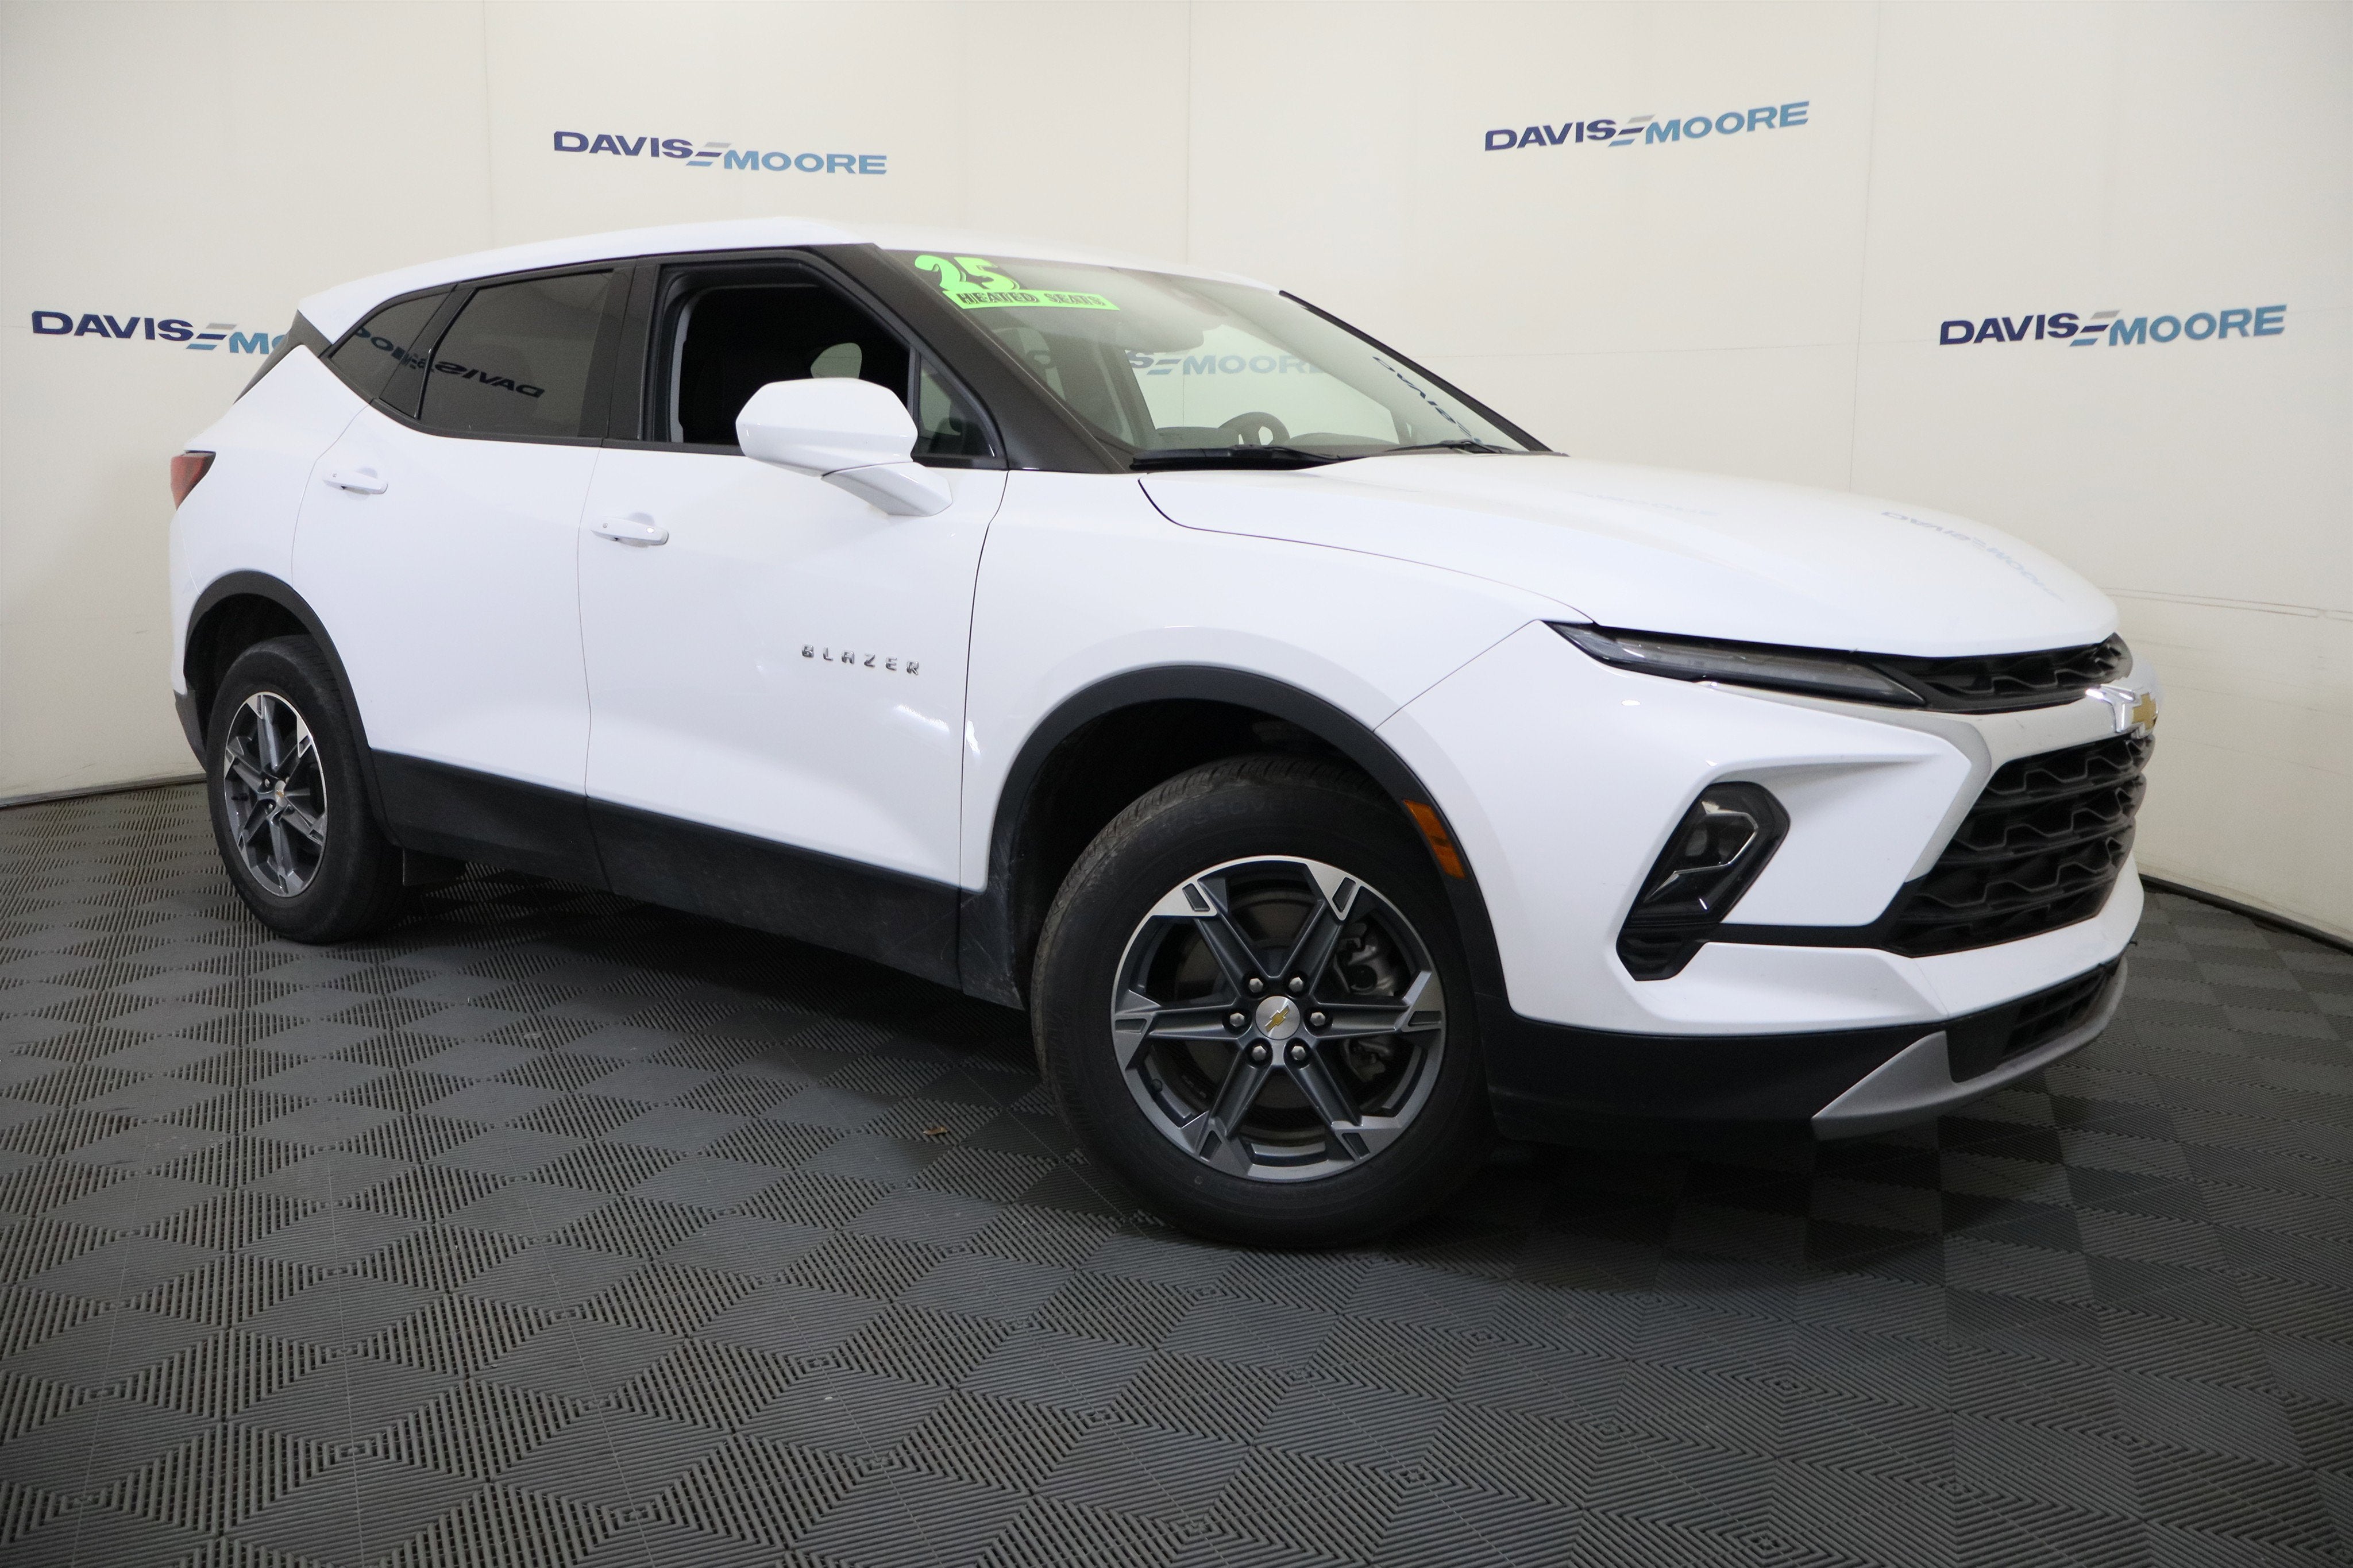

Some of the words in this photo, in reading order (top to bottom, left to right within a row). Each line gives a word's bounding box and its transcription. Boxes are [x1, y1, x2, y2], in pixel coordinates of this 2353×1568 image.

[1485, 119, 1616, 151] DAVIS
[1645, 101, 1809, 144] MOORE
[554, 131, 693, 159] DAVIS
[724, 150, 887, 174] MOORE
[915, 254, 1020, 291] 25
[956, 292, 1039, 304] HEATED
[1043, 293, 1106, 306] SEATS
[32, 311, 194, 341] DAVIS
[1939, 313, 2080, 346] DAVIS
[2109, 304, 2287, 346] MOORE
[802, 644, 919, 675] BLAZER
